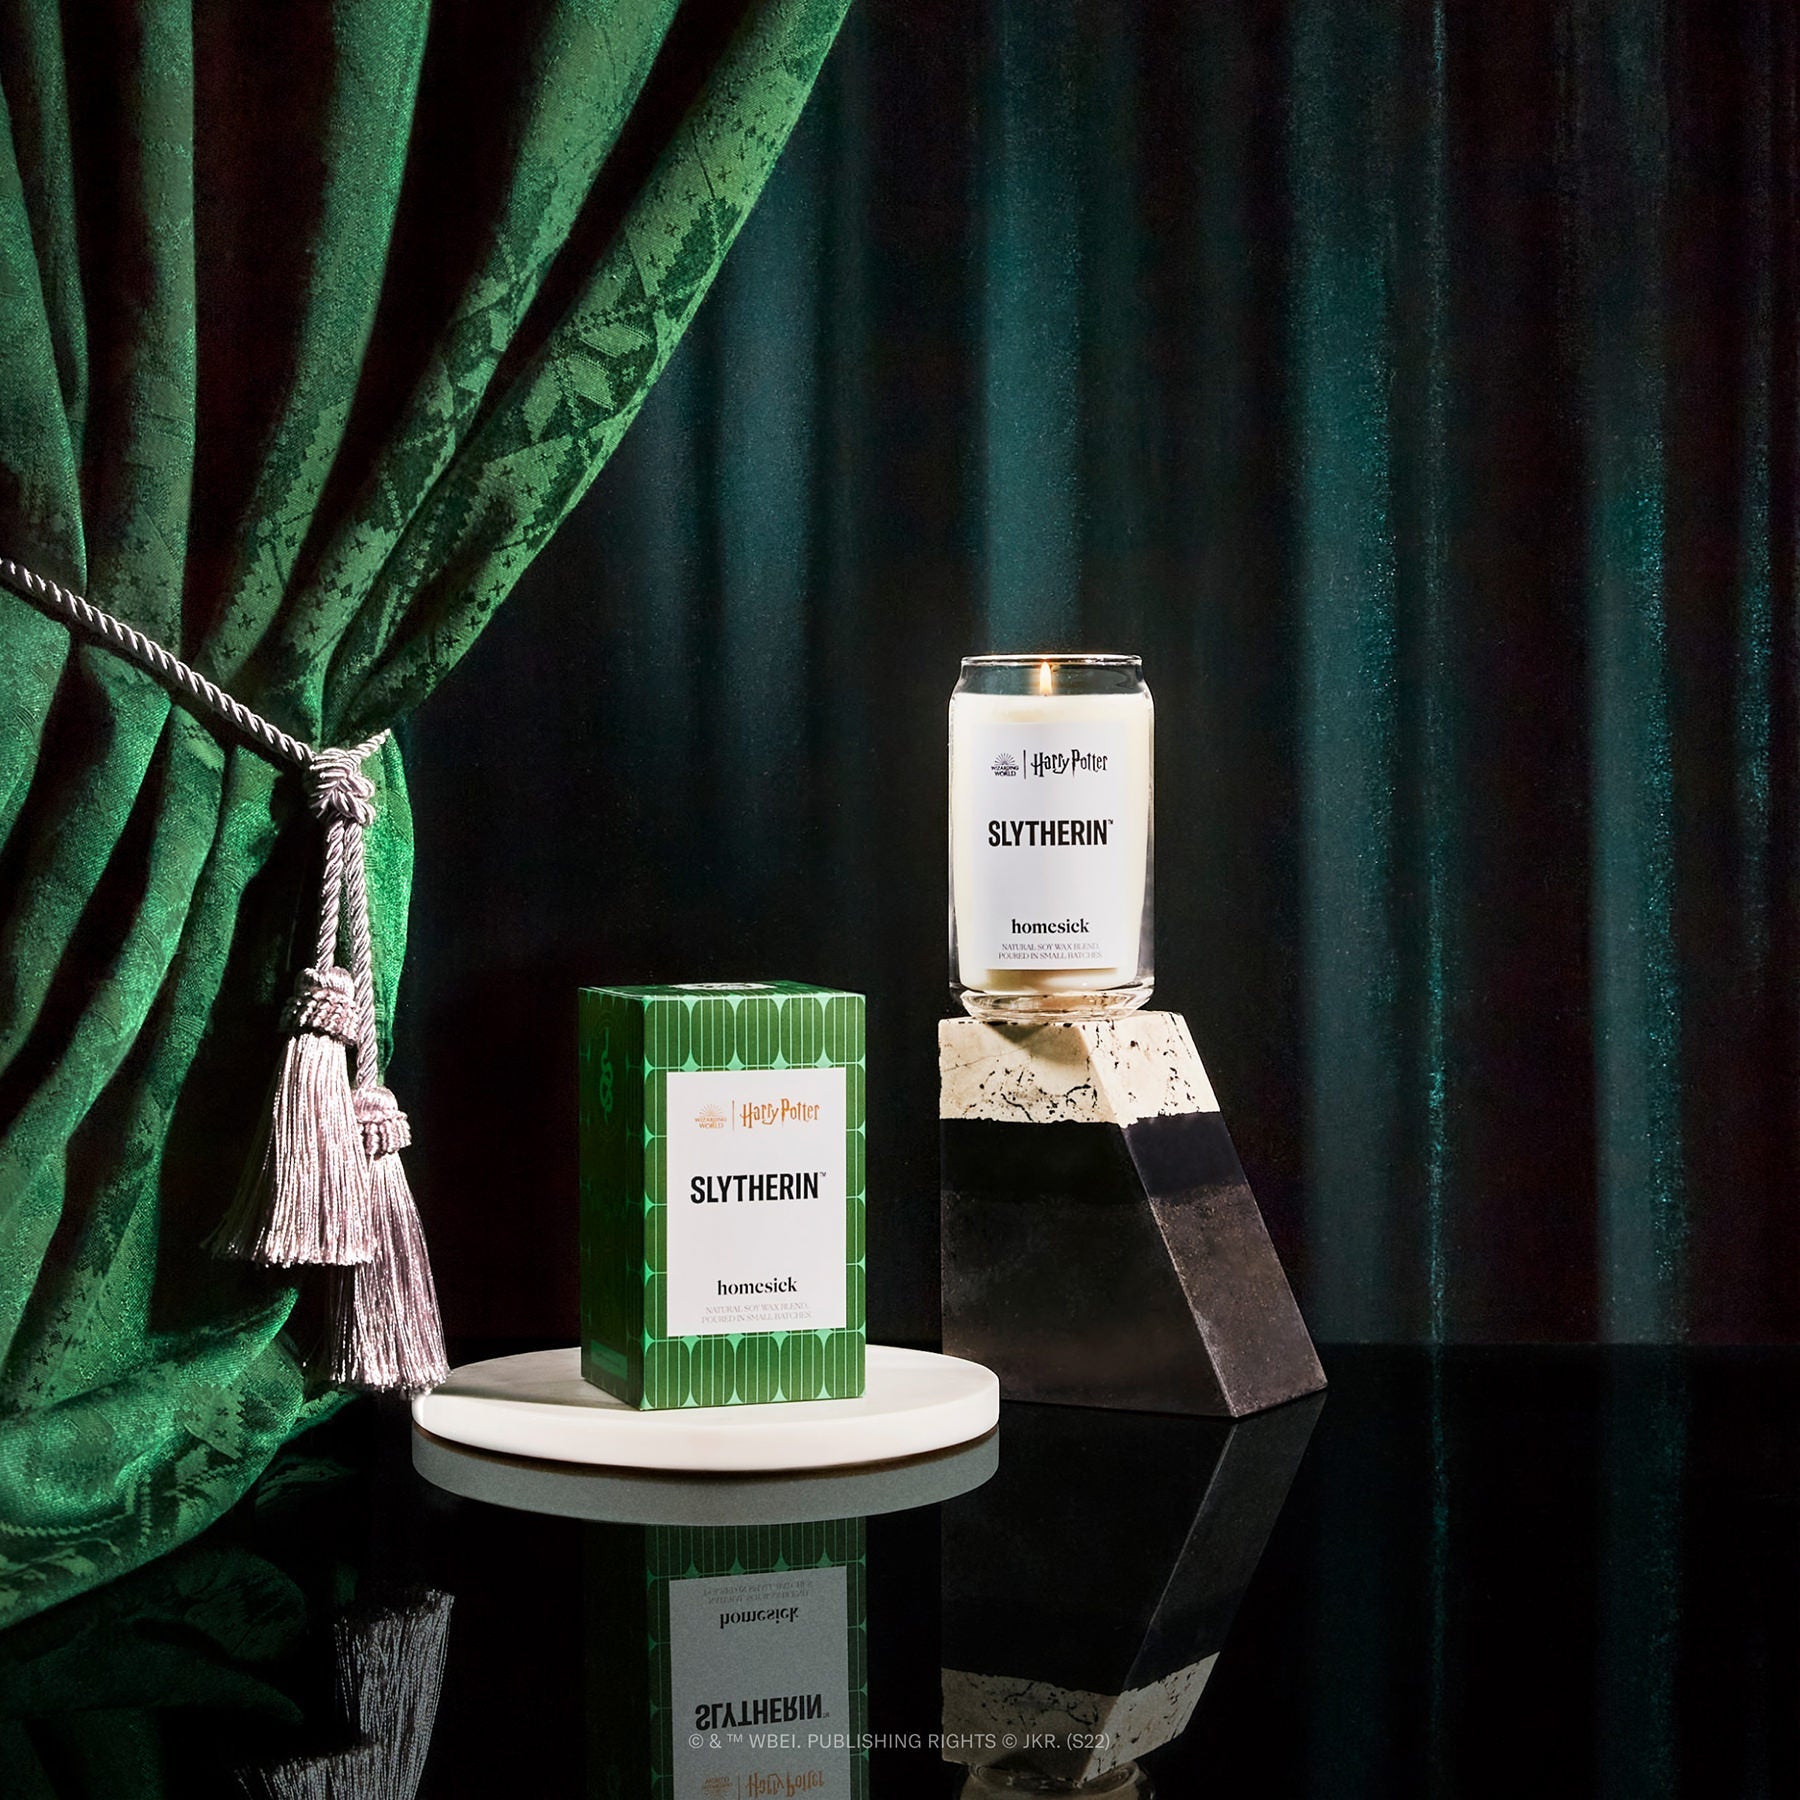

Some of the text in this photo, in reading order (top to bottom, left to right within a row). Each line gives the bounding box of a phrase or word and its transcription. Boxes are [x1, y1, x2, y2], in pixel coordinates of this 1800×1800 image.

[1030, 748, 1108, 778] Harry Potter
[1011, 918, 1090, 934] homesick
[998, 952, 1029, 960] POURED
[1030, 952, 1038, 960] IN
[1039, 951, 1066, 960] SMALL
[1002, 943, 1035, 951] NATURAL
[1037, 943, 1053, 951] SOY
[1054, 943, 1072, 951] WAX
[739, 1098, 820, 1129] Harry Potter
[717, 1276, 798, 1296] homesick
